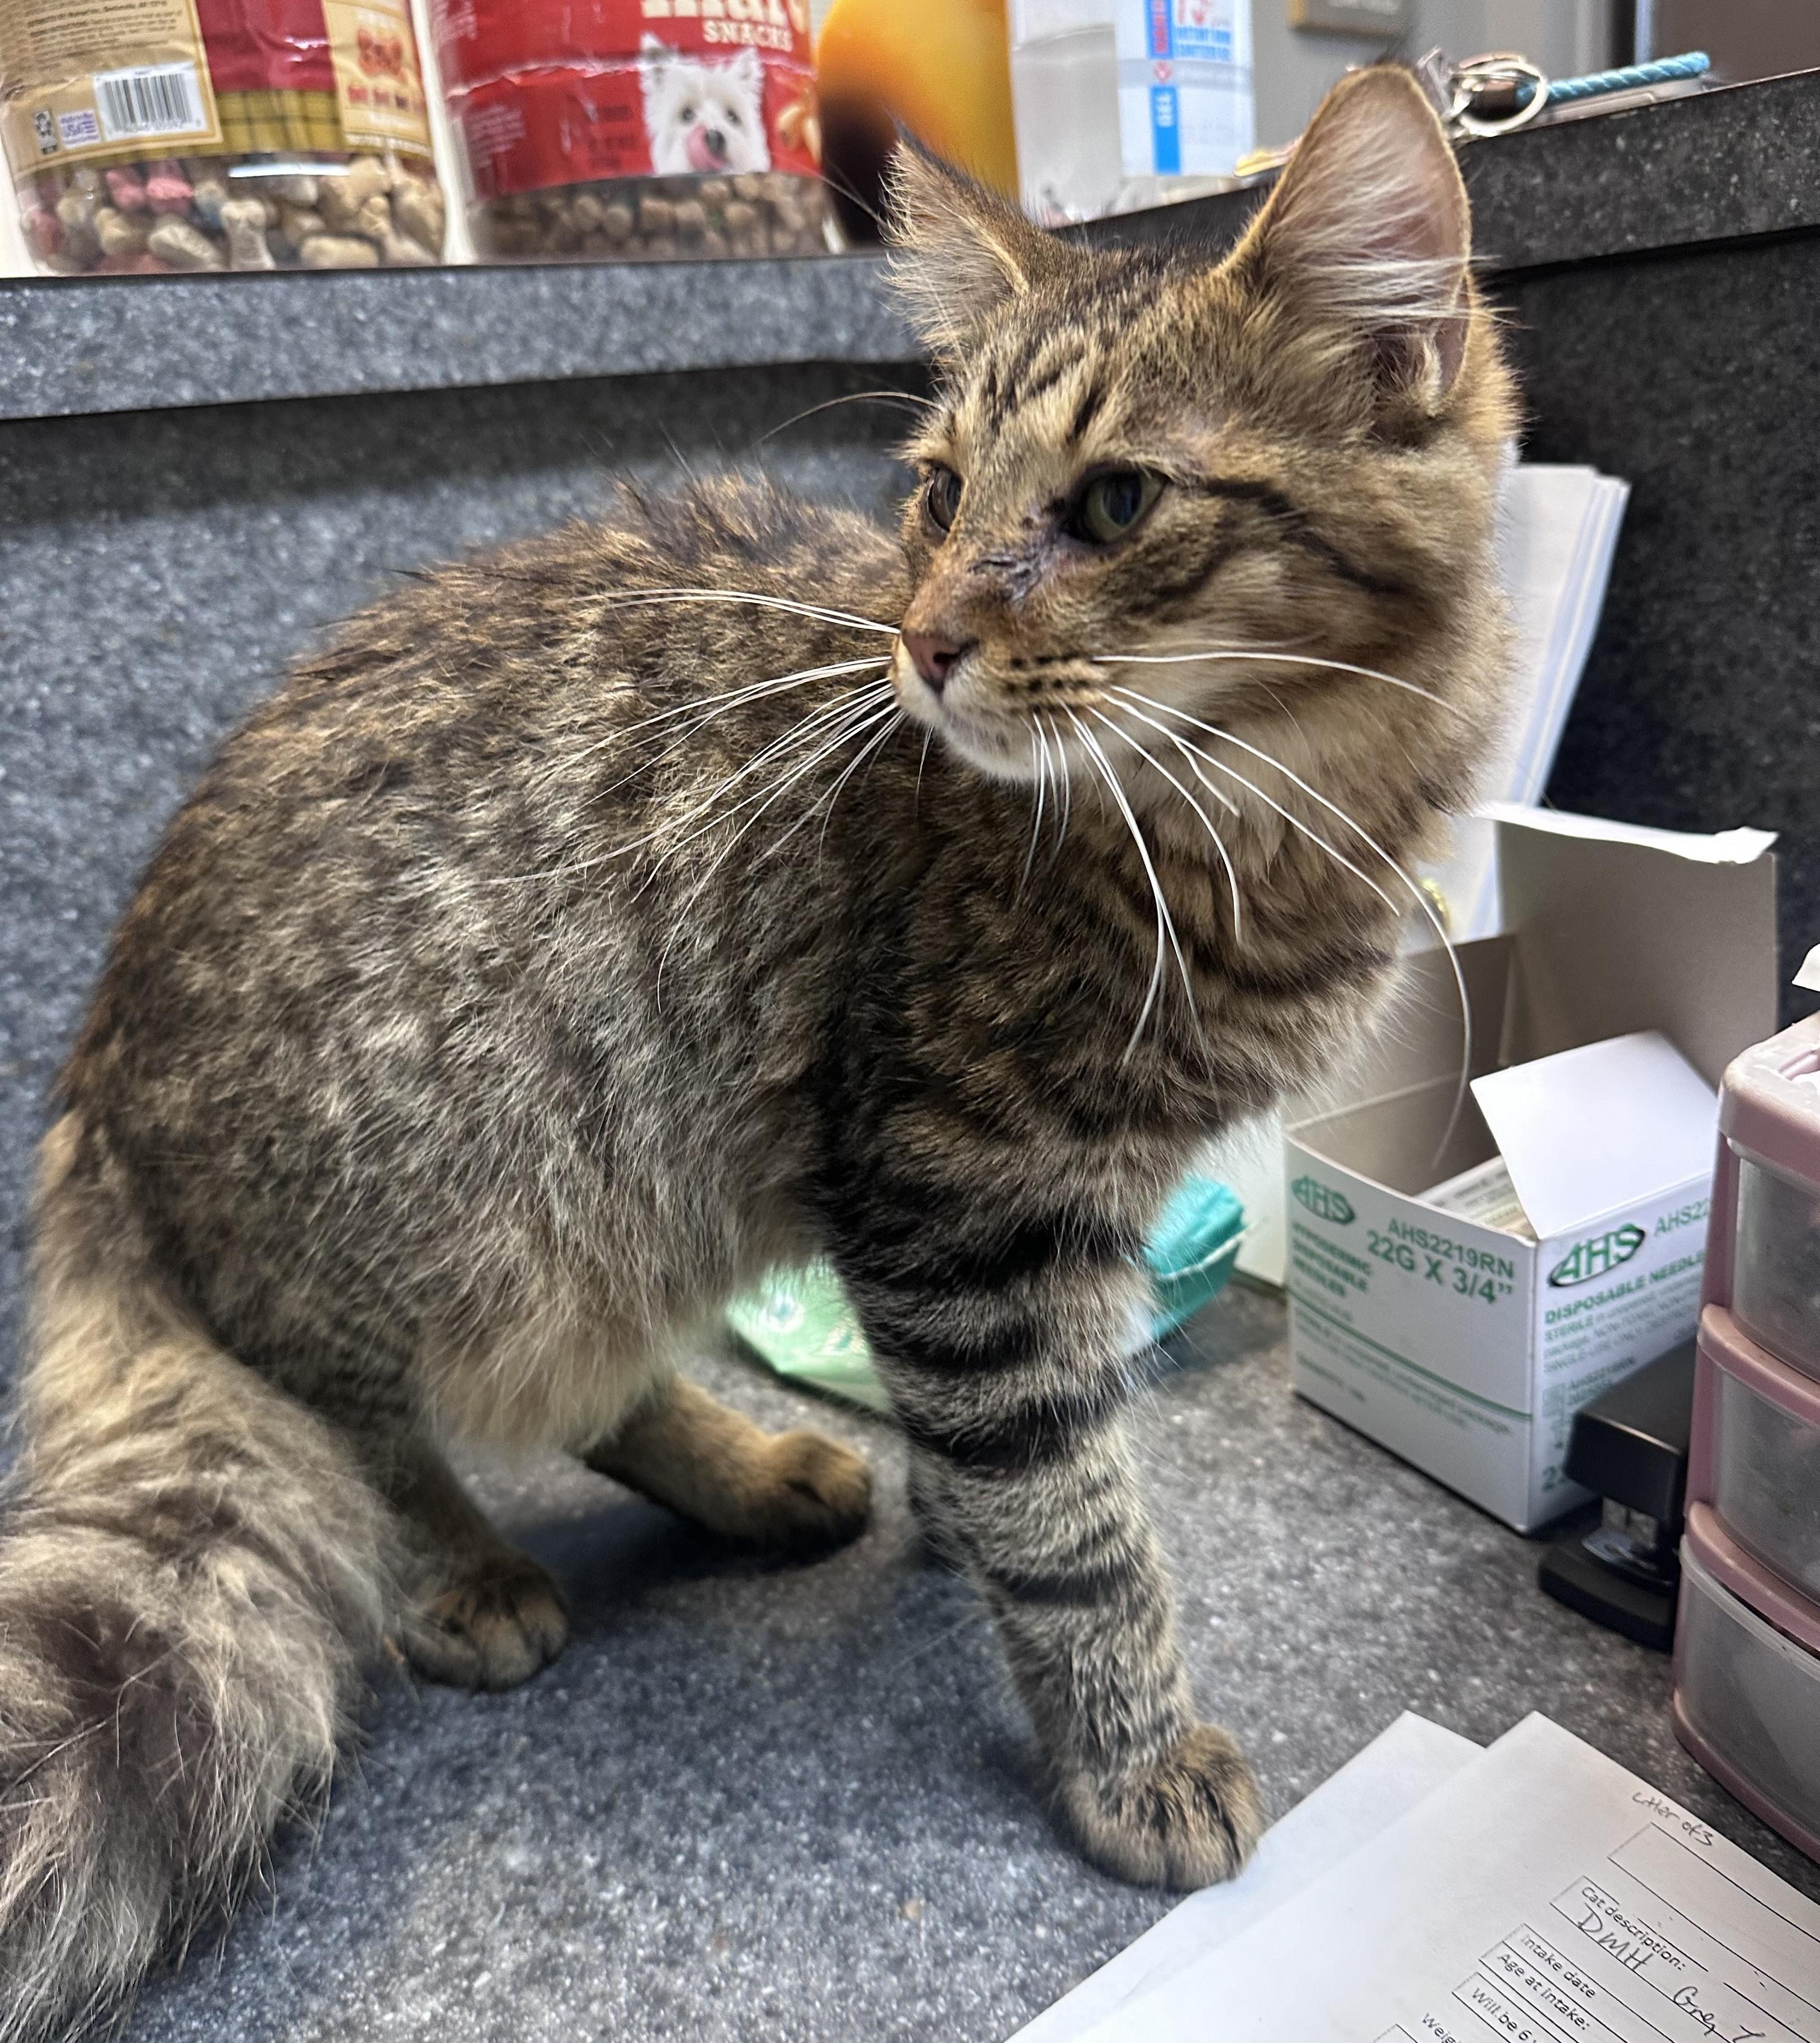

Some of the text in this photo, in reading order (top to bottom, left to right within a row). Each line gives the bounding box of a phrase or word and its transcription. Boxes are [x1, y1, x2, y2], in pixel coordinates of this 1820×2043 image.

[702, 19, 793, 52] SNACKS
[1367, 1229, 1416, 1272] 22G
[1424, 1254, 1443, 1286] X
[1387, 1217, 1514, 1280] AHS2219RN
[1549, 1222, 1644, 1285] AHS
[1545, 1274, 1645, 1324] DISPOSABLE
[1577, 1902, 1654, 1970] DMH
[1582, 1886, 1686, 1971] Cat description:
[1497, 1953, 1591, 2031] Age at intake:
[1521, 1933, 1596, 1998] Intake date
[1422, 2012, 1461, 2043] Weig
[1472, 1987, 1532, 2041] Will be 6
